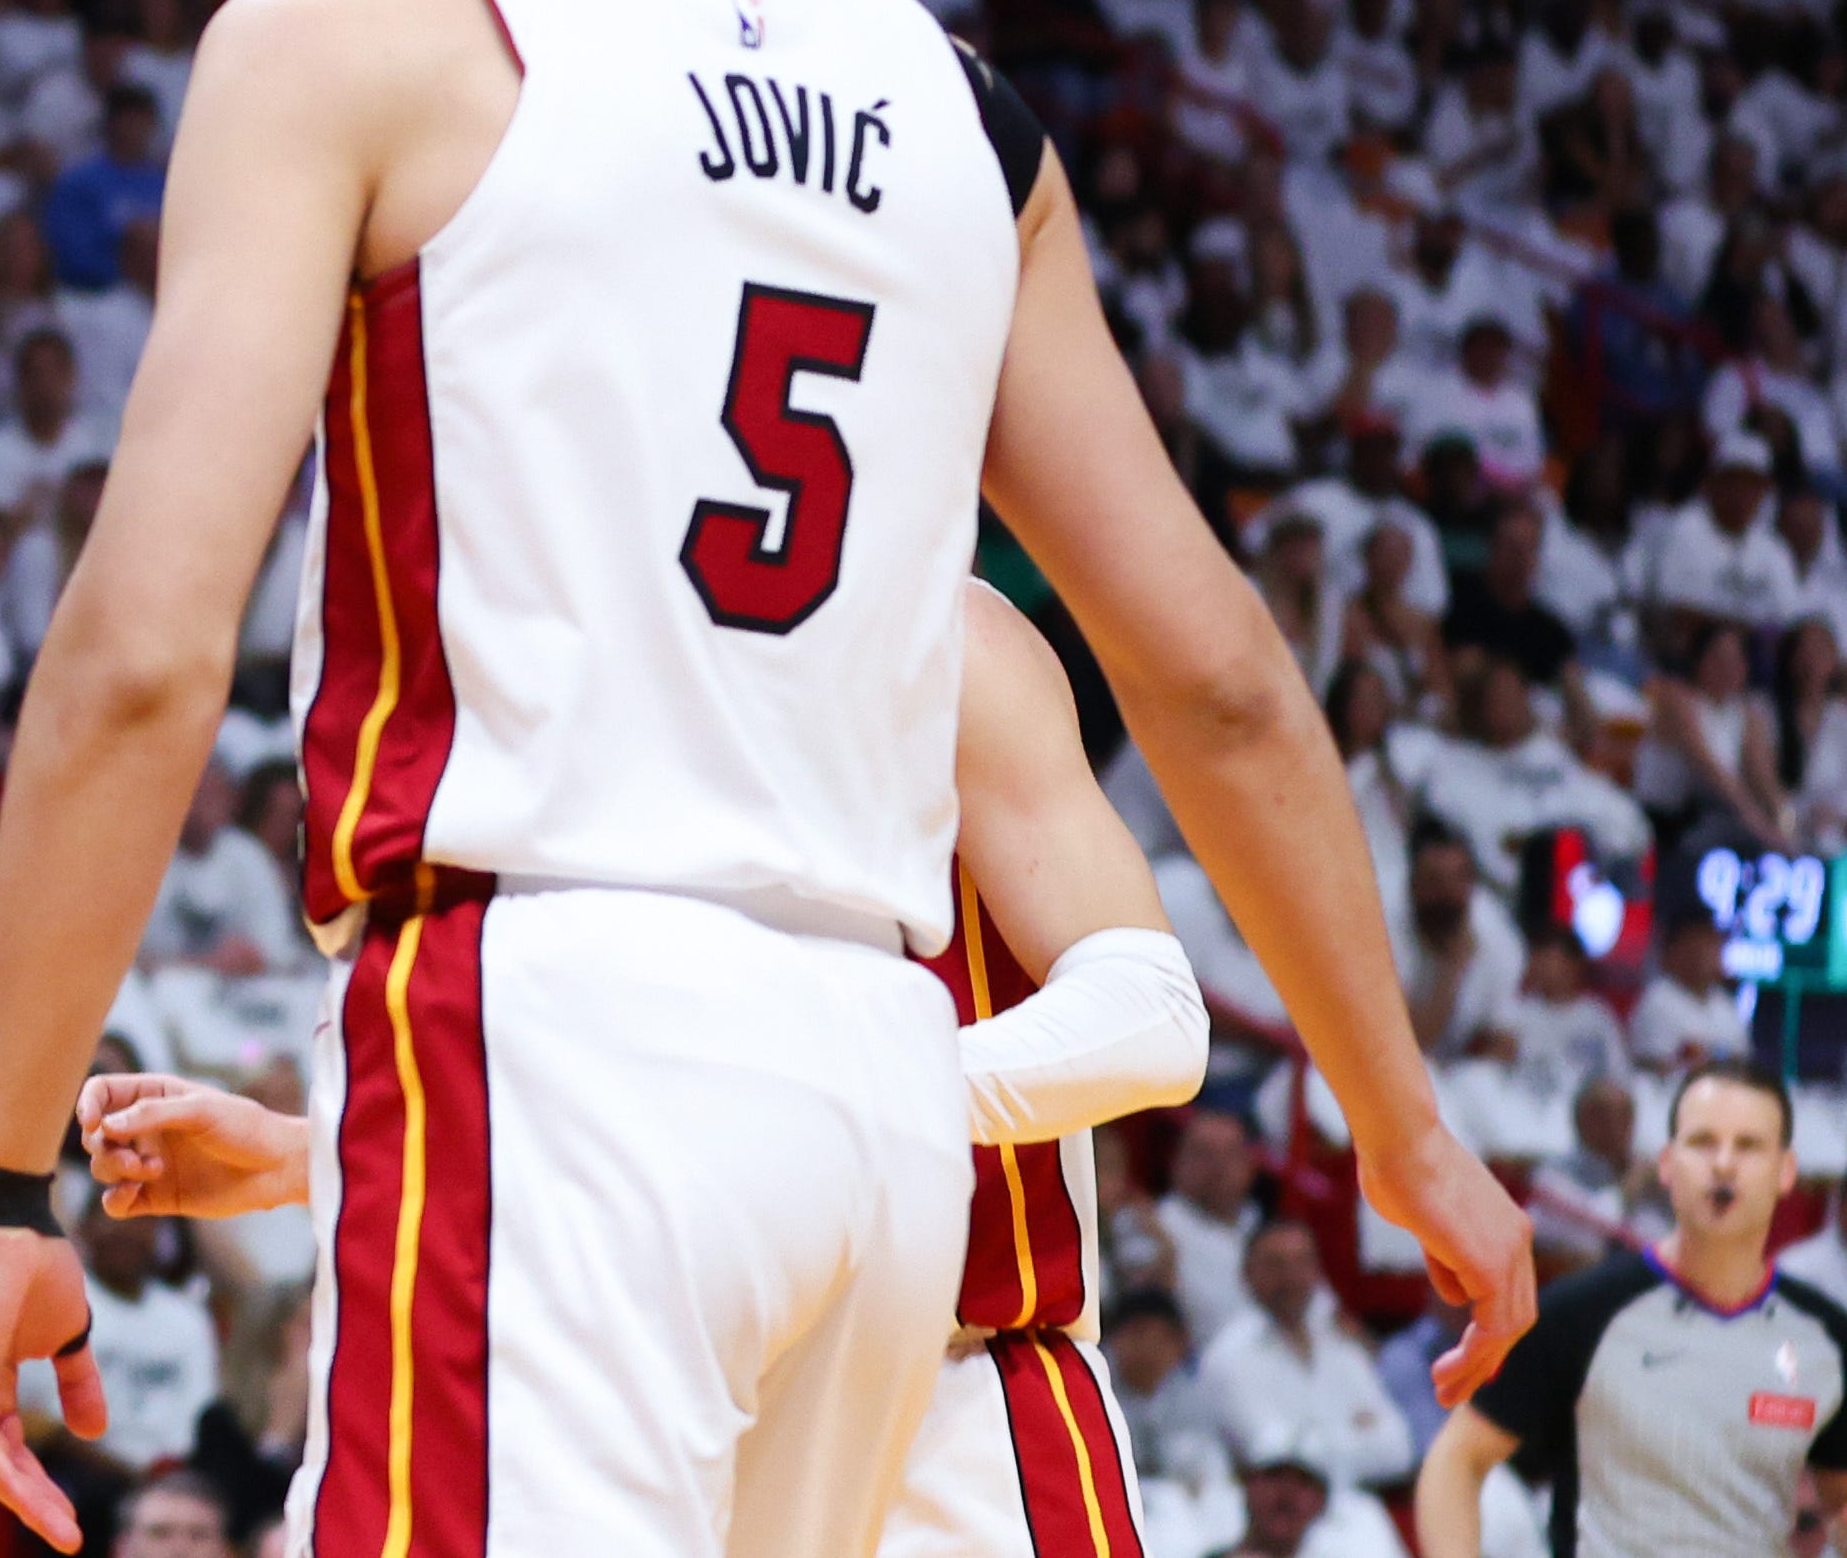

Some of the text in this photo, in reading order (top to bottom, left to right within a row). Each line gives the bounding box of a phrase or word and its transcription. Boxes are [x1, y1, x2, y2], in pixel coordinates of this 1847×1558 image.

[688, 71, 893, 214] JOVIĆ
[679, 280, 876, 637] 5
[1695, 846, 1826, 945] 9:29
